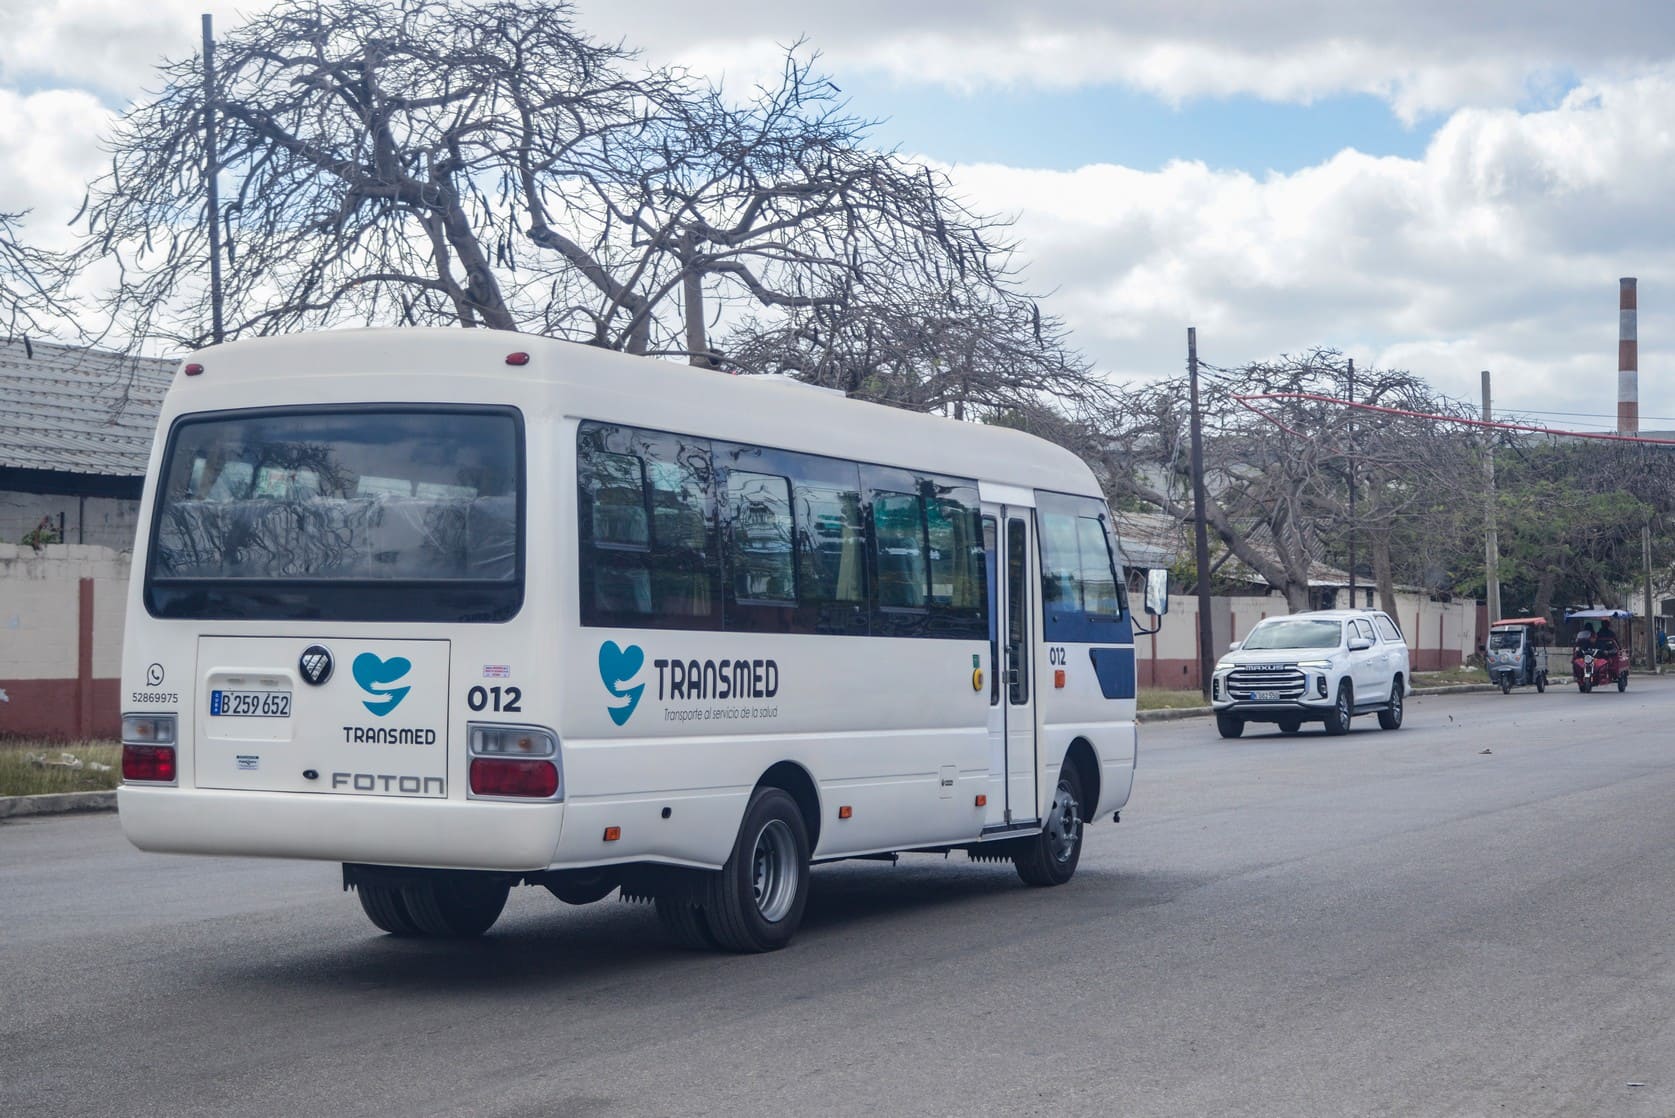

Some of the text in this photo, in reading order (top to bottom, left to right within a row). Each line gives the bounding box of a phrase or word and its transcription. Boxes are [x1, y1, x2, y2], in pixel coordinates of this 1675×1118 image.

[1049, 646, 1067, 666] 012
[653, 659, 779, 701] TRANSMED
[131, 692, 179, 704] 52869975
[221, 695, 231, 714] B
[232, 695, 260, 715] 259
[262, 693, 289, 715] 652
[467, 685, 522, 713] 012
[664, 705, 778, 724] Transporte al servicio de la salud
[343, 726, 436, 745] TRANSMED
[331, 772, 445, 794] FOTON
